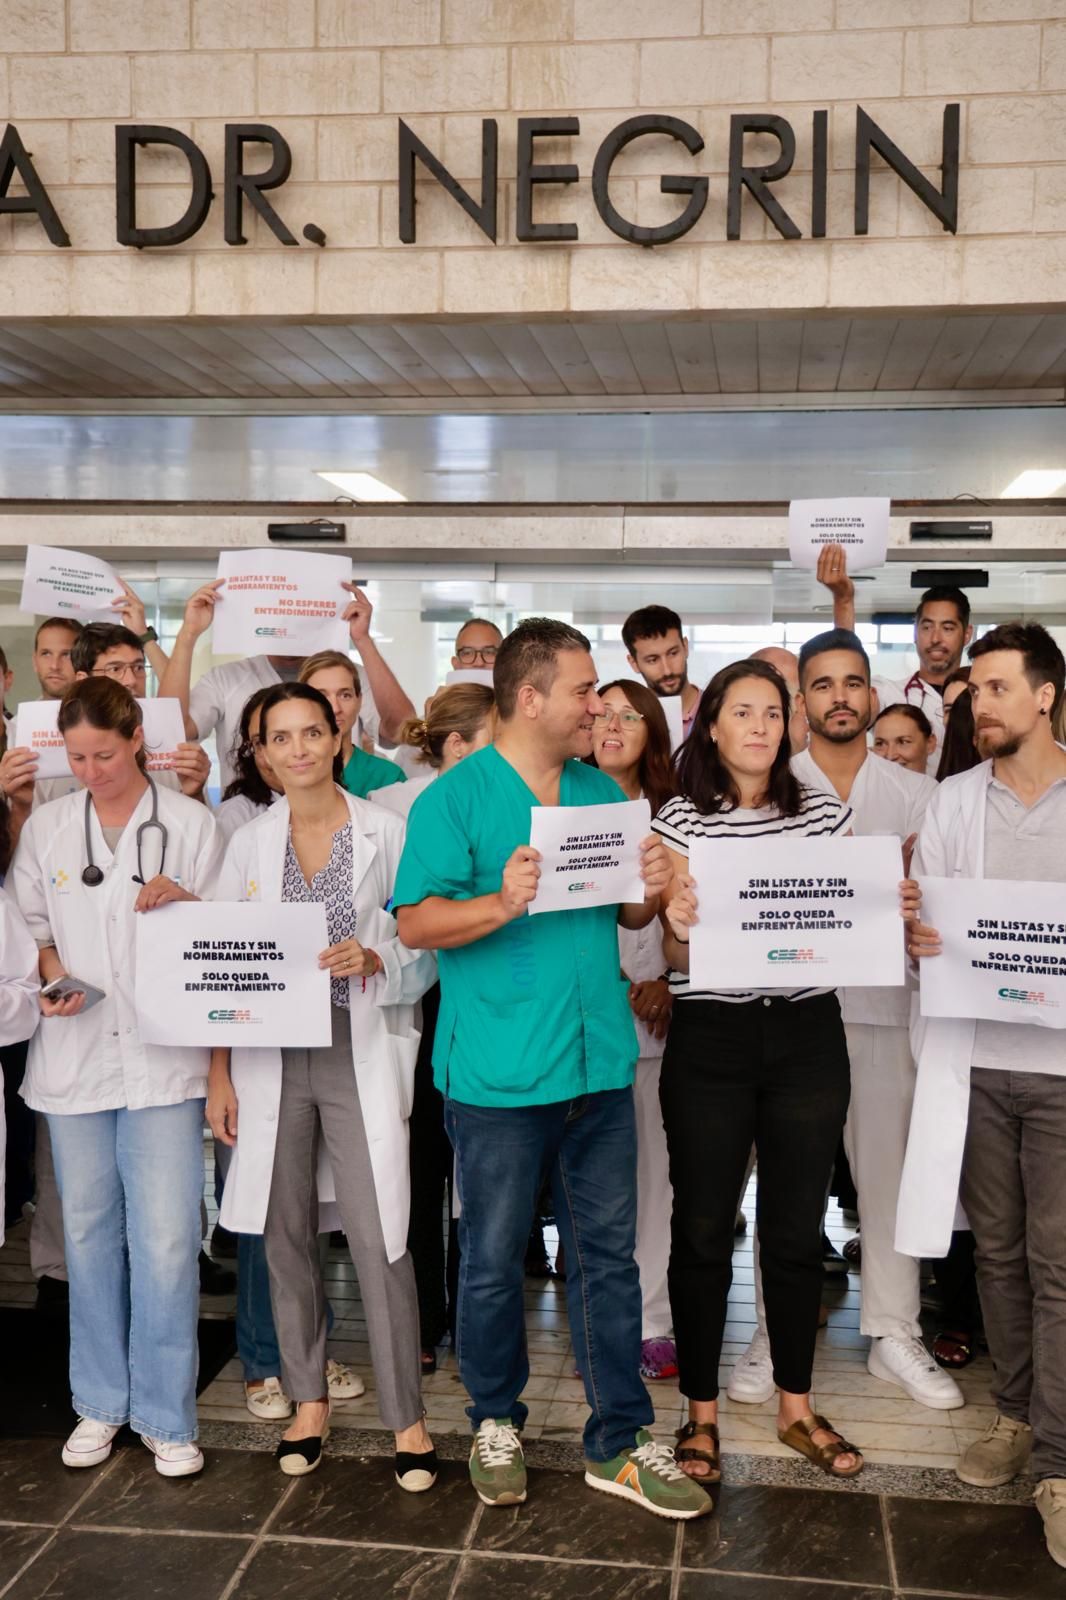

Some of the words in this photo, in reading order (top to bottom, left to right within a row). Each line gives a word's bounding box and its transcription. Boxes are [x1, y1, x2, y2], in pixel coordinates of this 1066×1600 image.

[115, 124, 326, 249] DR.
[399, 103, 960, 247] NEGRIN
[296, 600, 336, 608] ESPERES
[254, 608, 336, 617] ENTENDIMIENTO
[560, 840, 625, 851] NOMBRAMIENTOS
[556, 861, 619, 872] ENFRENTAMIENTO
[749, 879, 769, 888] SIN
[772, 878, 814, 887] LISTAS
[816, 878, 824, 887] Y
[826, 878, 847, 887] SIN
[739, 889, 854, 899] NOMBRAMIENTOS
[759, 911, 790, 919] SOLO
[793, 910, 835, 920] QUEDA
[741, 920, 852, 930] ENFRENTAMIENTO
[977, 919, 998, 928] SIN
[1001, 921, 1044, 932] LISTAS
[1047, 924, 1055, 932] Y
[1057, 924, 1066, 933] S
[192, 941, 210, 950] SIN
[212, 941, 246, 950] LISTAS
[248, 942, 255, 950] Y
[257, 941, 276, 950] SIN
[183, 952, 284, 961] NOMBRAMIENTOS
[988, 952, 1021, 962] SOLO
[1024, 954, 1066, 965] QUEDA
[202, 972, 230, 980] SOLO
[231, 972, 270, 983] QUEDA
[185, 983, 286, 991] ENFRENTAMIENTO
